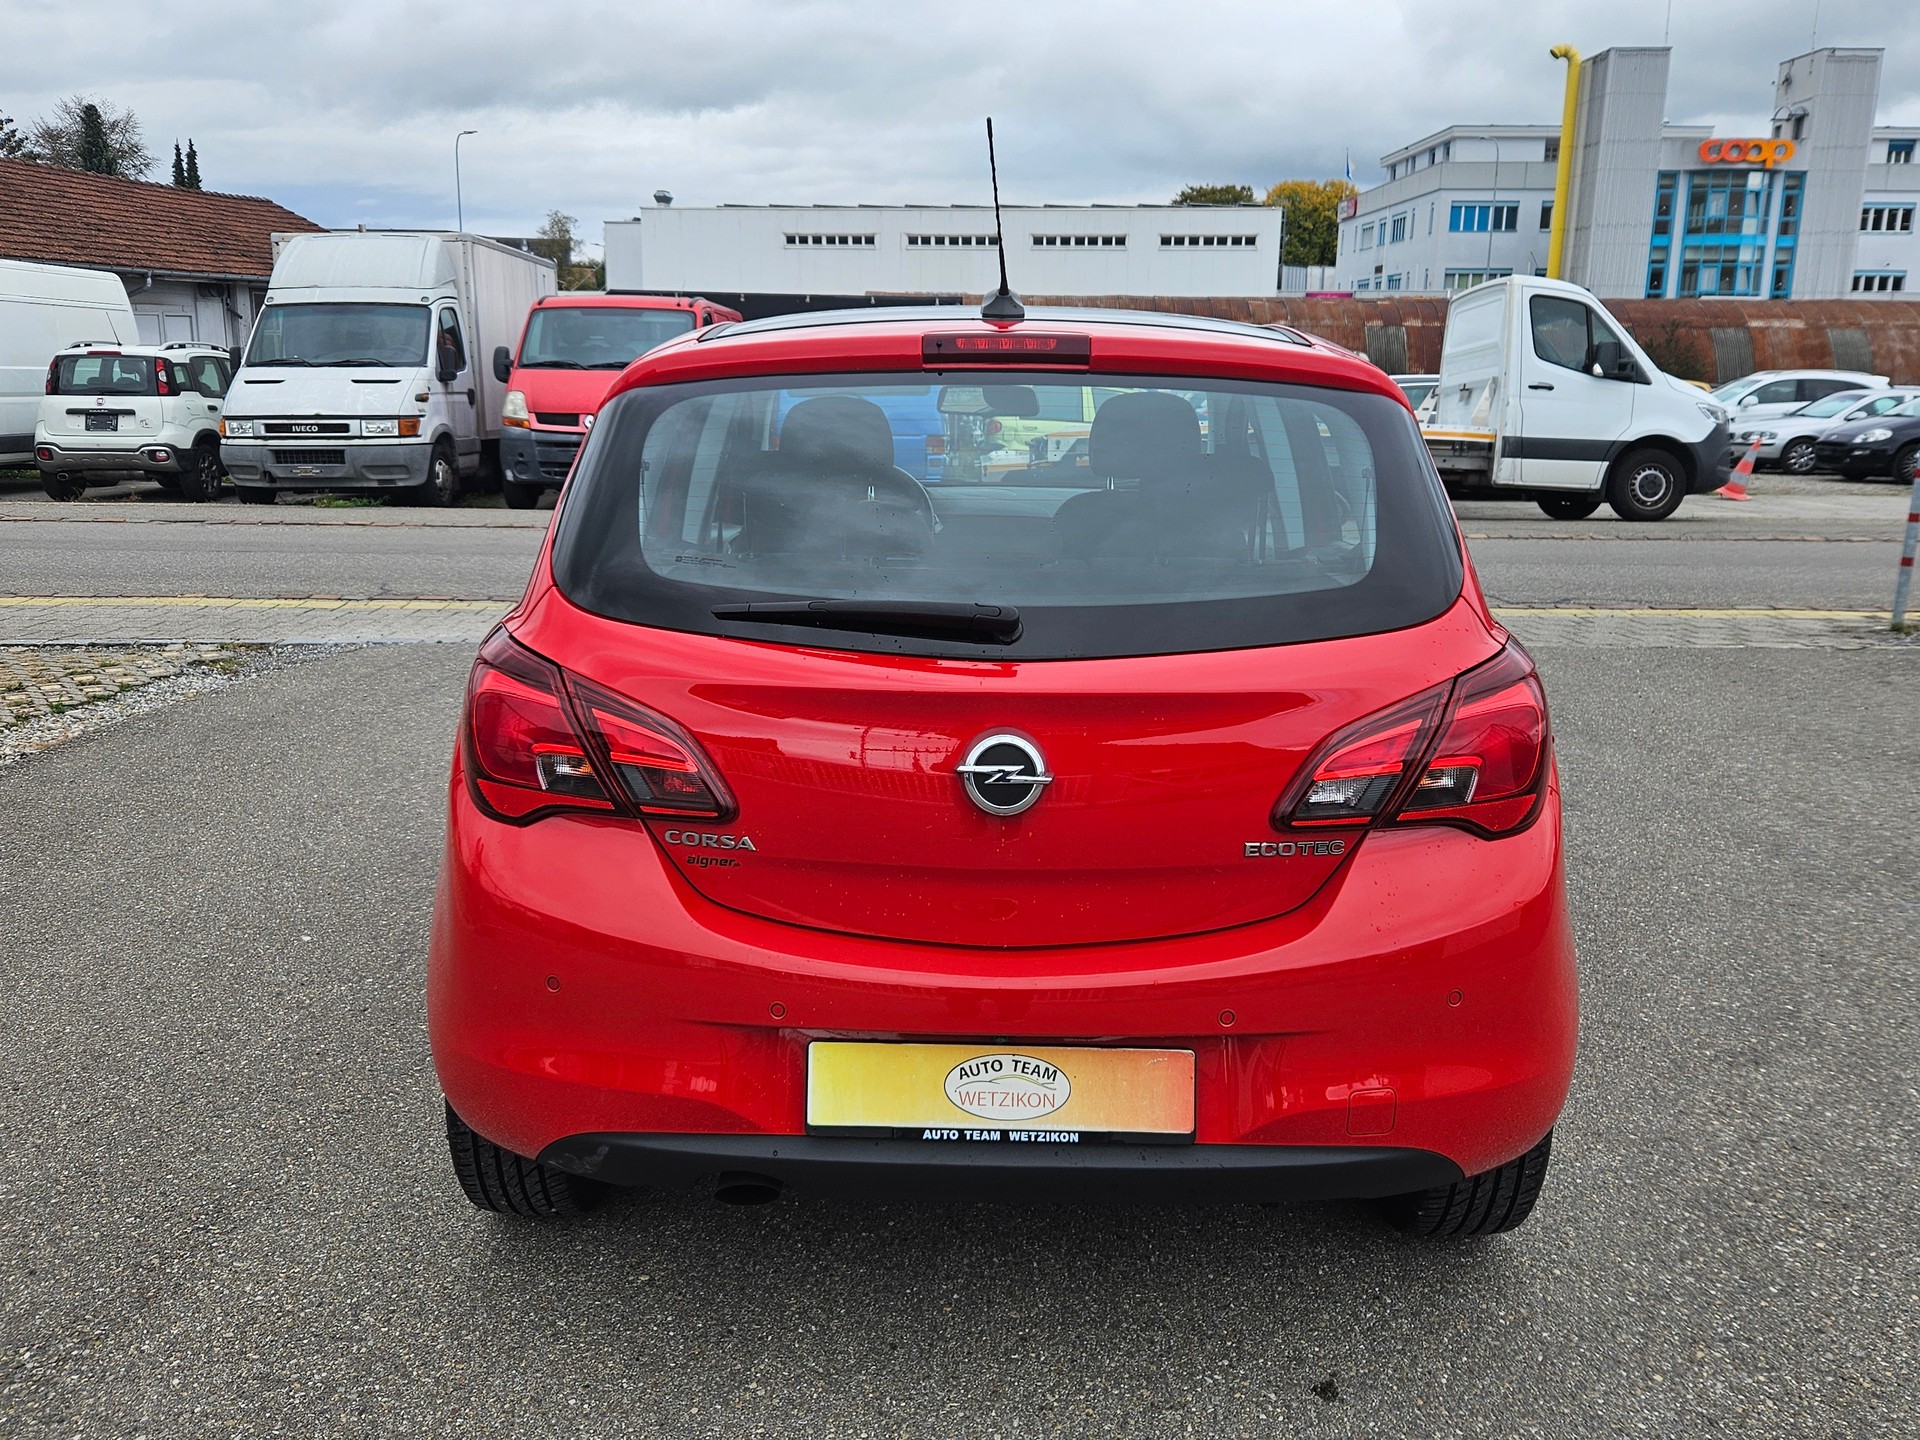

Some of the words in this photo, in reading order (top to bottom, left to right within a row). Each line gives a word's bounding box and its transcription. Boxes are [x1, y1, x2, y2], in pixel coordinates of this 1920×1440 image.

[1698, 139, 1796, 169] coop
[664, 830, 757, 851] CORSA
[1244, 840, 1345, 857] ECOTEC
[959, 1059, 1003, 1080] AUTO
[1012, 1059, 1058, 1081] TEAM
[958, 1091, 1056, 1108] WETZIKON
[922, 1129, 959, 1140] AUTO
[964, 1130, 1001, 1141] TEAM
[1009, 1131, 1079, 1143] WETZIKON
